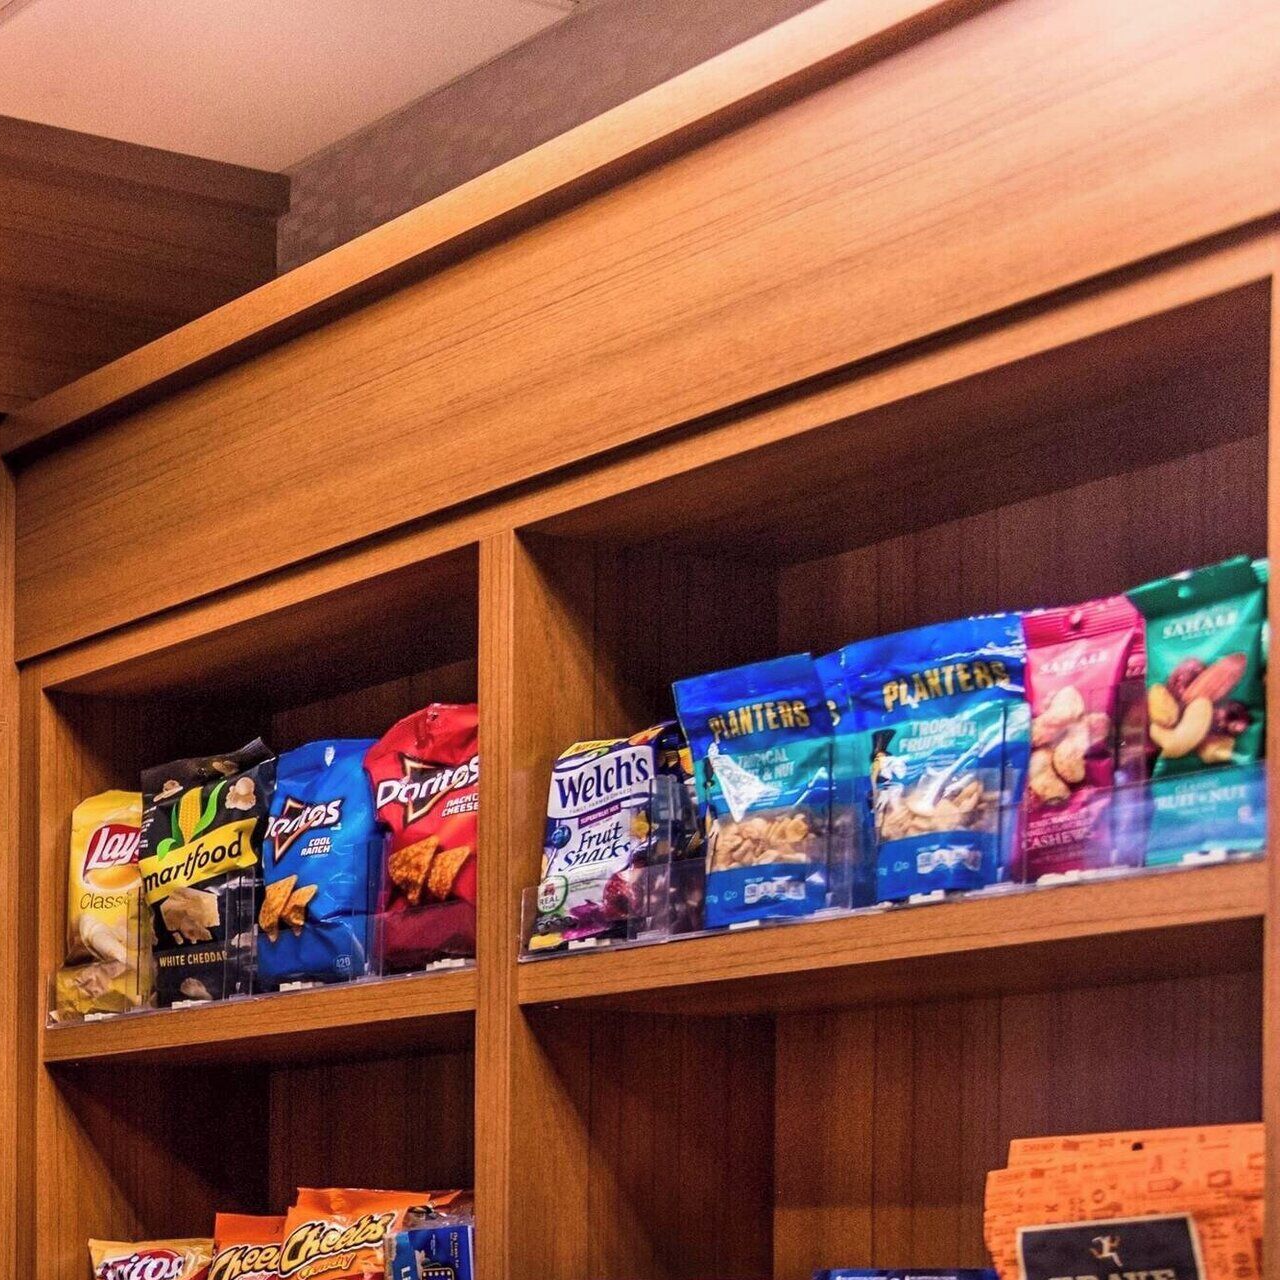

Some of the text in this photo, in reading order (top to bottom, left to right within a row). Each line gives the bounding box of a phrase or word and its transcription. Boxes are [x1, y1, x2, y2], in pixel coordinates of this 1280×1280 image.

[882, 660, 1010, 711] PLANTERS
[709, 701, 810, 744] PLANTERS
[555, 753, 649, 808] Welch's
[301, 845, 330, 856] RANCH
[308, 837, 331, 847] COOL
[579, 822, 623, 851] Fruit
[142, 831, 242, 893] martfood
[559, 842, 630, 871] Snacks
[159, 951, 228, 967] WHITE CHEDDAR
[280, 1212, 396, 1278] Cheetos
